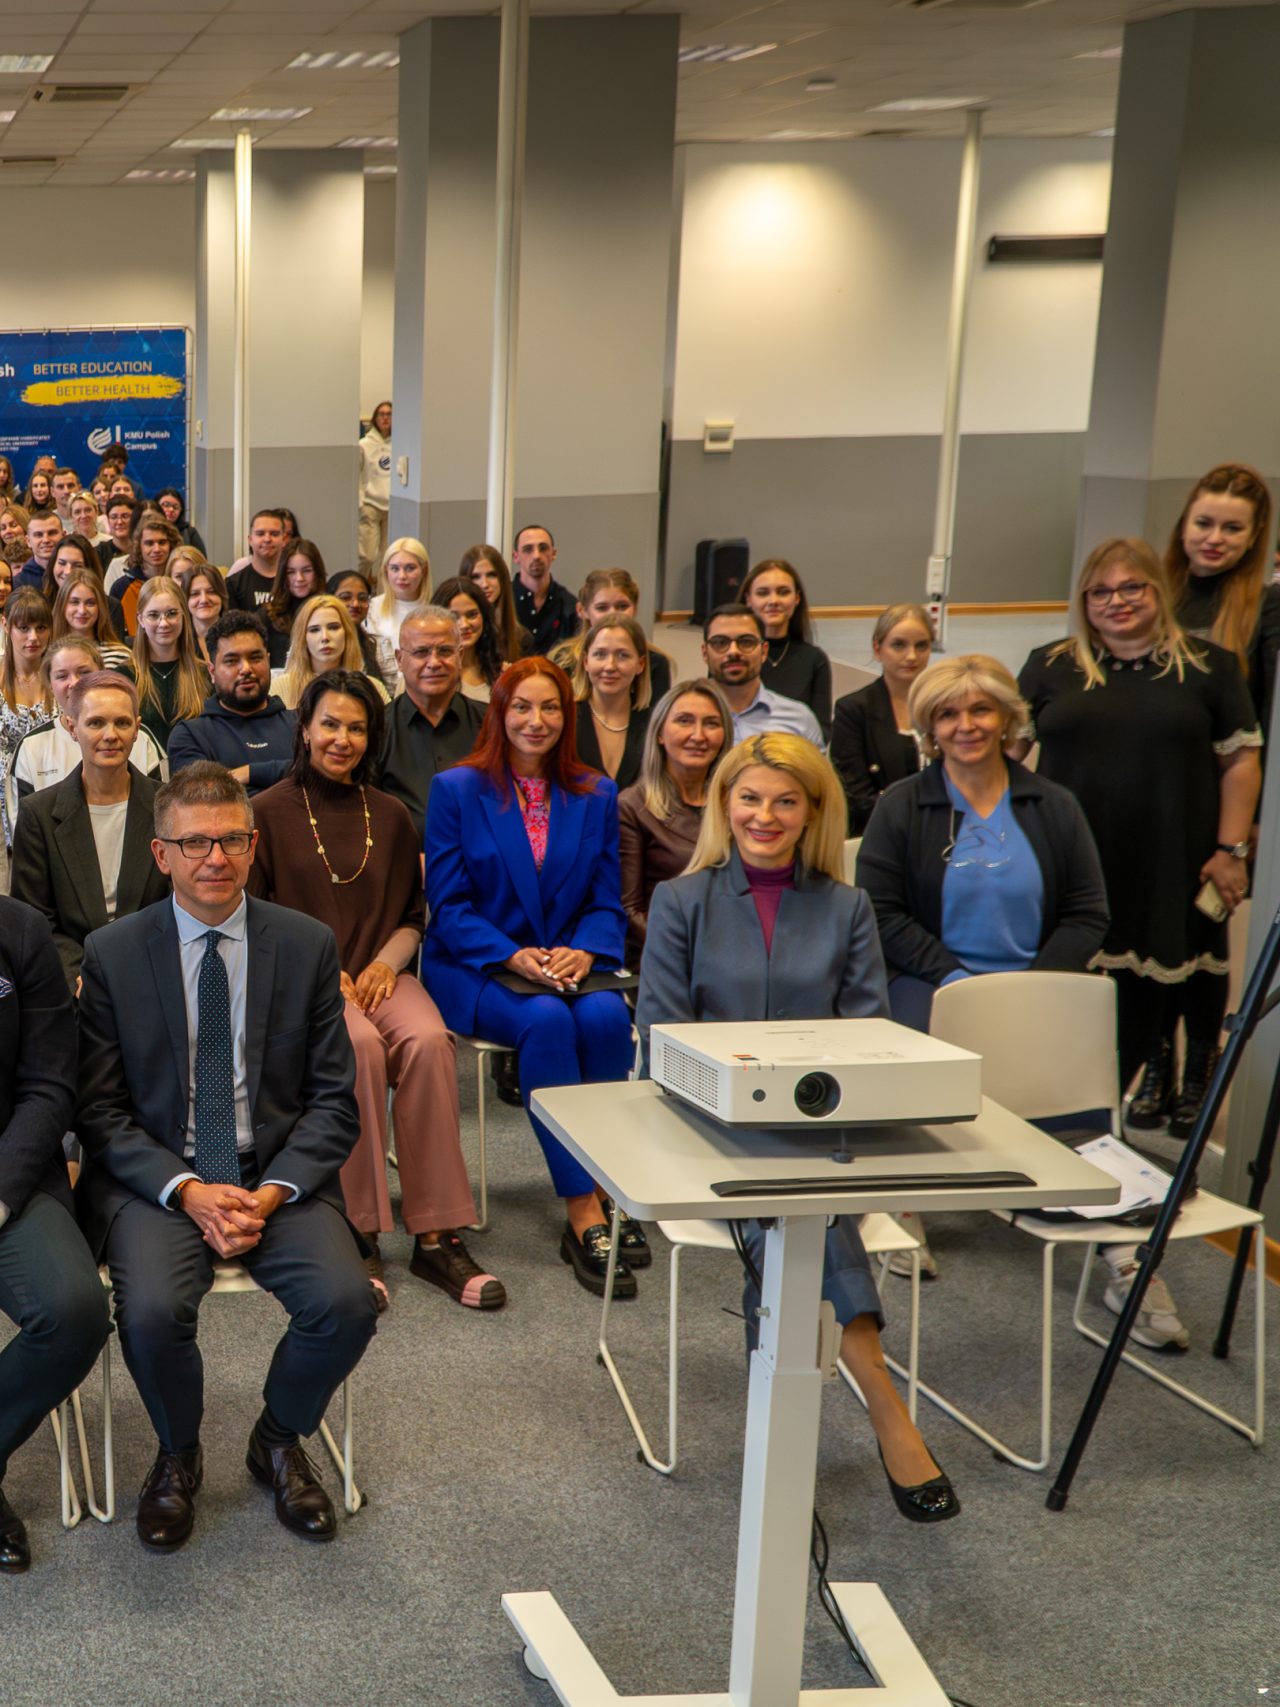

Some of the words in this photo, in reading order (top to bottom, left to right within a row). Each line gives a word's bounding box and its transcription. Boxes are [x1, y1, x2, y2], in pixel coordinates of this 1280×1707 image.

[33, 362, 78, 375] BETTER
[80, 361, 153, 374] EDUCATION
[55, 385, 100, 397] BETTER
[103, 383, 151, 396] HEALTH
